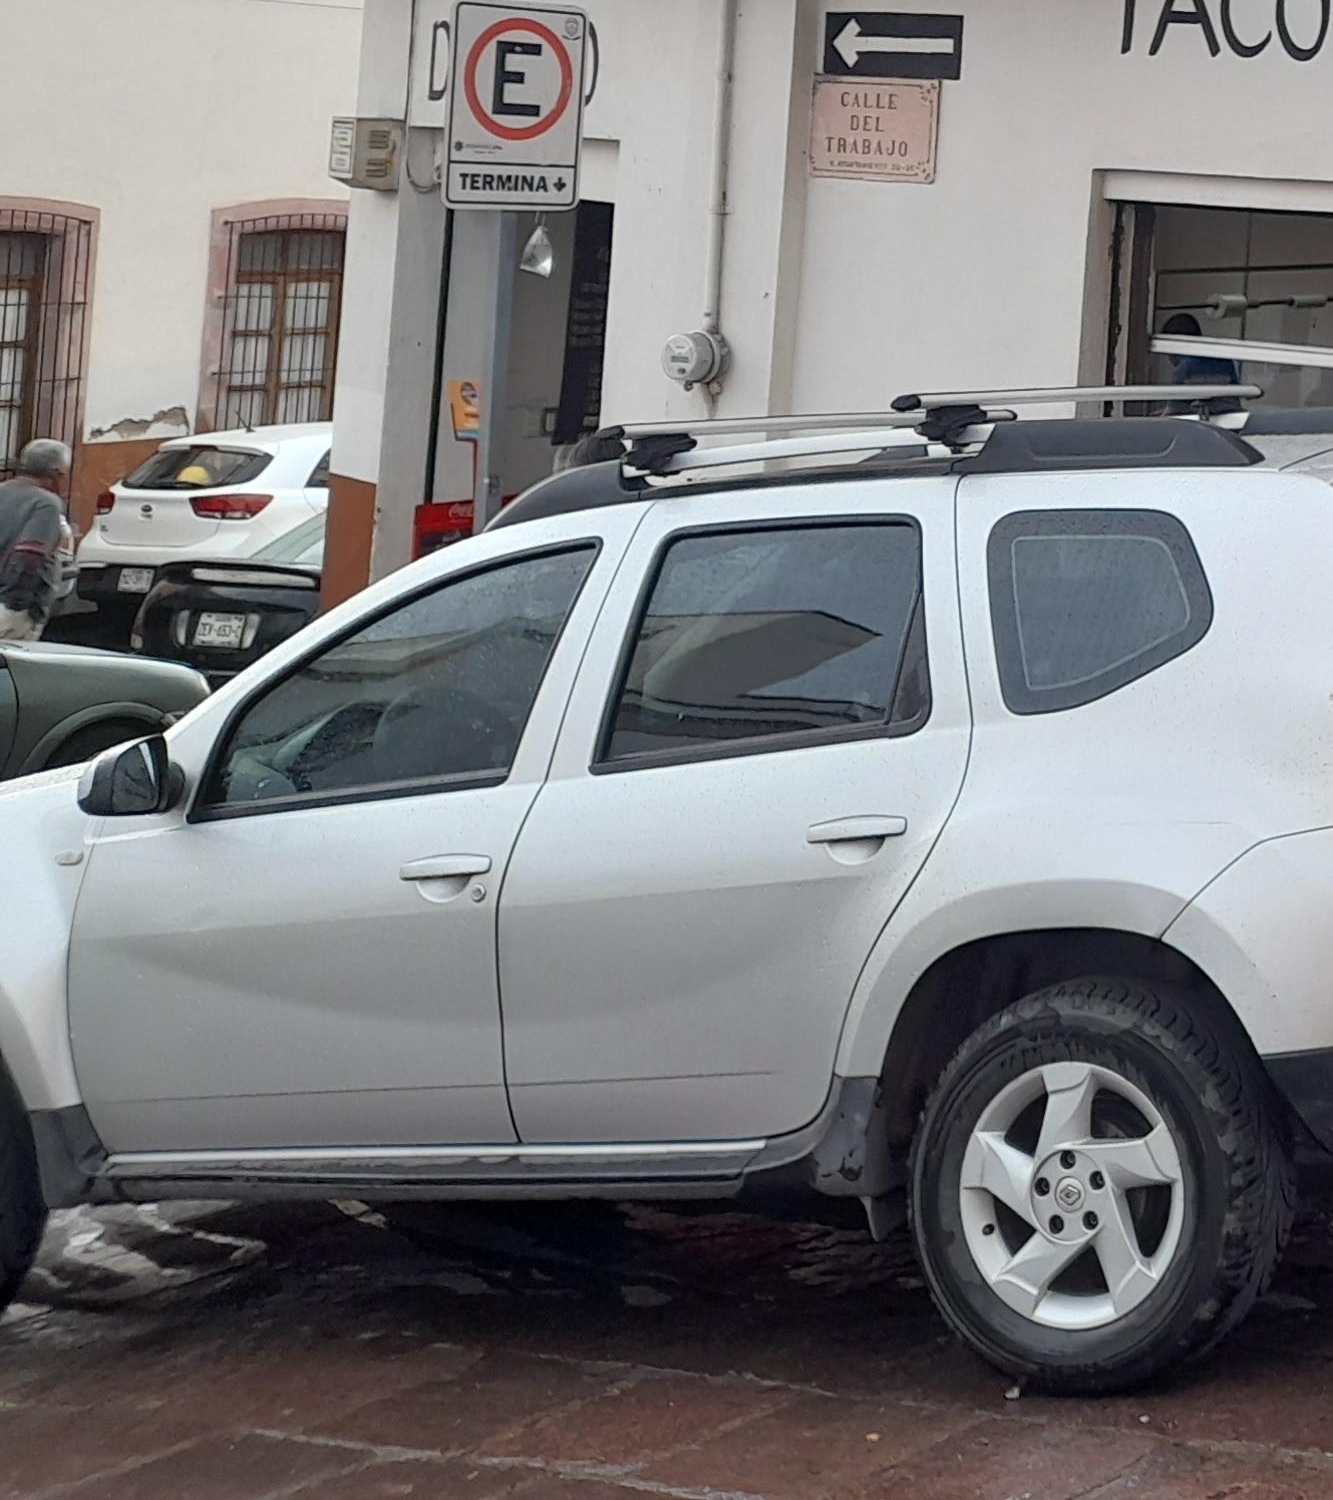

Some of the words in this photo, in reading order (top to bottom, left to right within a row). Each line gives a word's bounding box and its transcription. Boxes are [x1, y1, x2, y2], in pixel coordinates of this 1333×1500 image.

[492, 40, 542, 117] E
[841, 91, 898, 110] CALLE
[849, 114, 885, 132] DEL
[825, 136, 908, 157] TRABAJO
[459, 173, 549, 193] TERMINA
